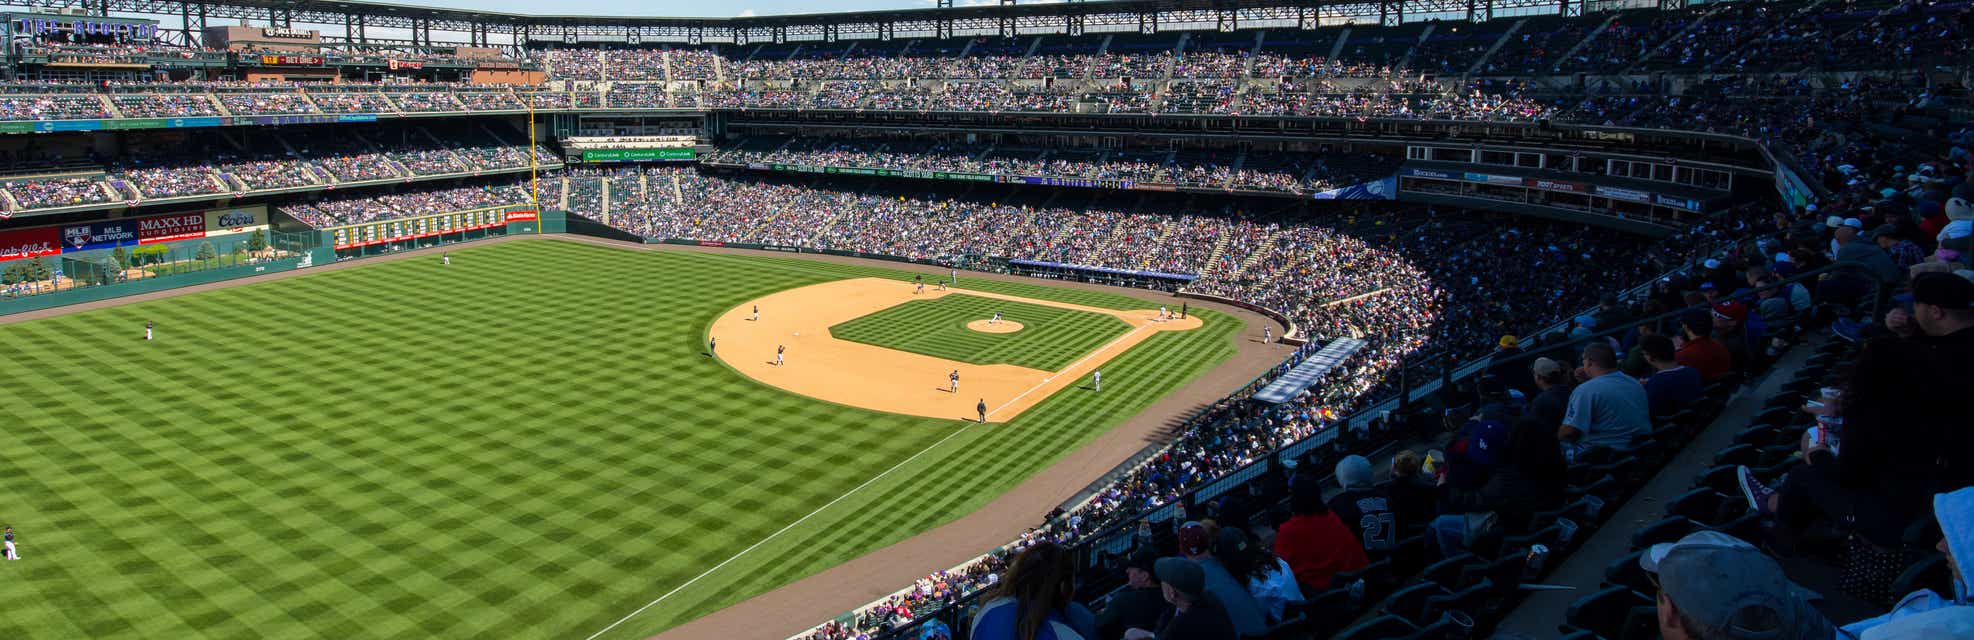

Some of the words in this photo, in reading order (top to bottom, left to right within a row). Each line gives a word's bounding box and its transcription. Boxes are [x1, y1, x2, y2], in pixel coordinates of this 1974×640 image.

[22, 18, 57, 34] THE
[73, 20, 160, 40] ROOFTOP
[140, 217, 182, 230] MAXX
[183, 215, 203, 225] HD
[217, 214, 254, 227] Coors
[66, 227, 90, 236] MLB
[92, 231, 134, 242] NETWORK
[104, 226, 122, 234] MLB
[1360, 512, 1396, 551] 27
